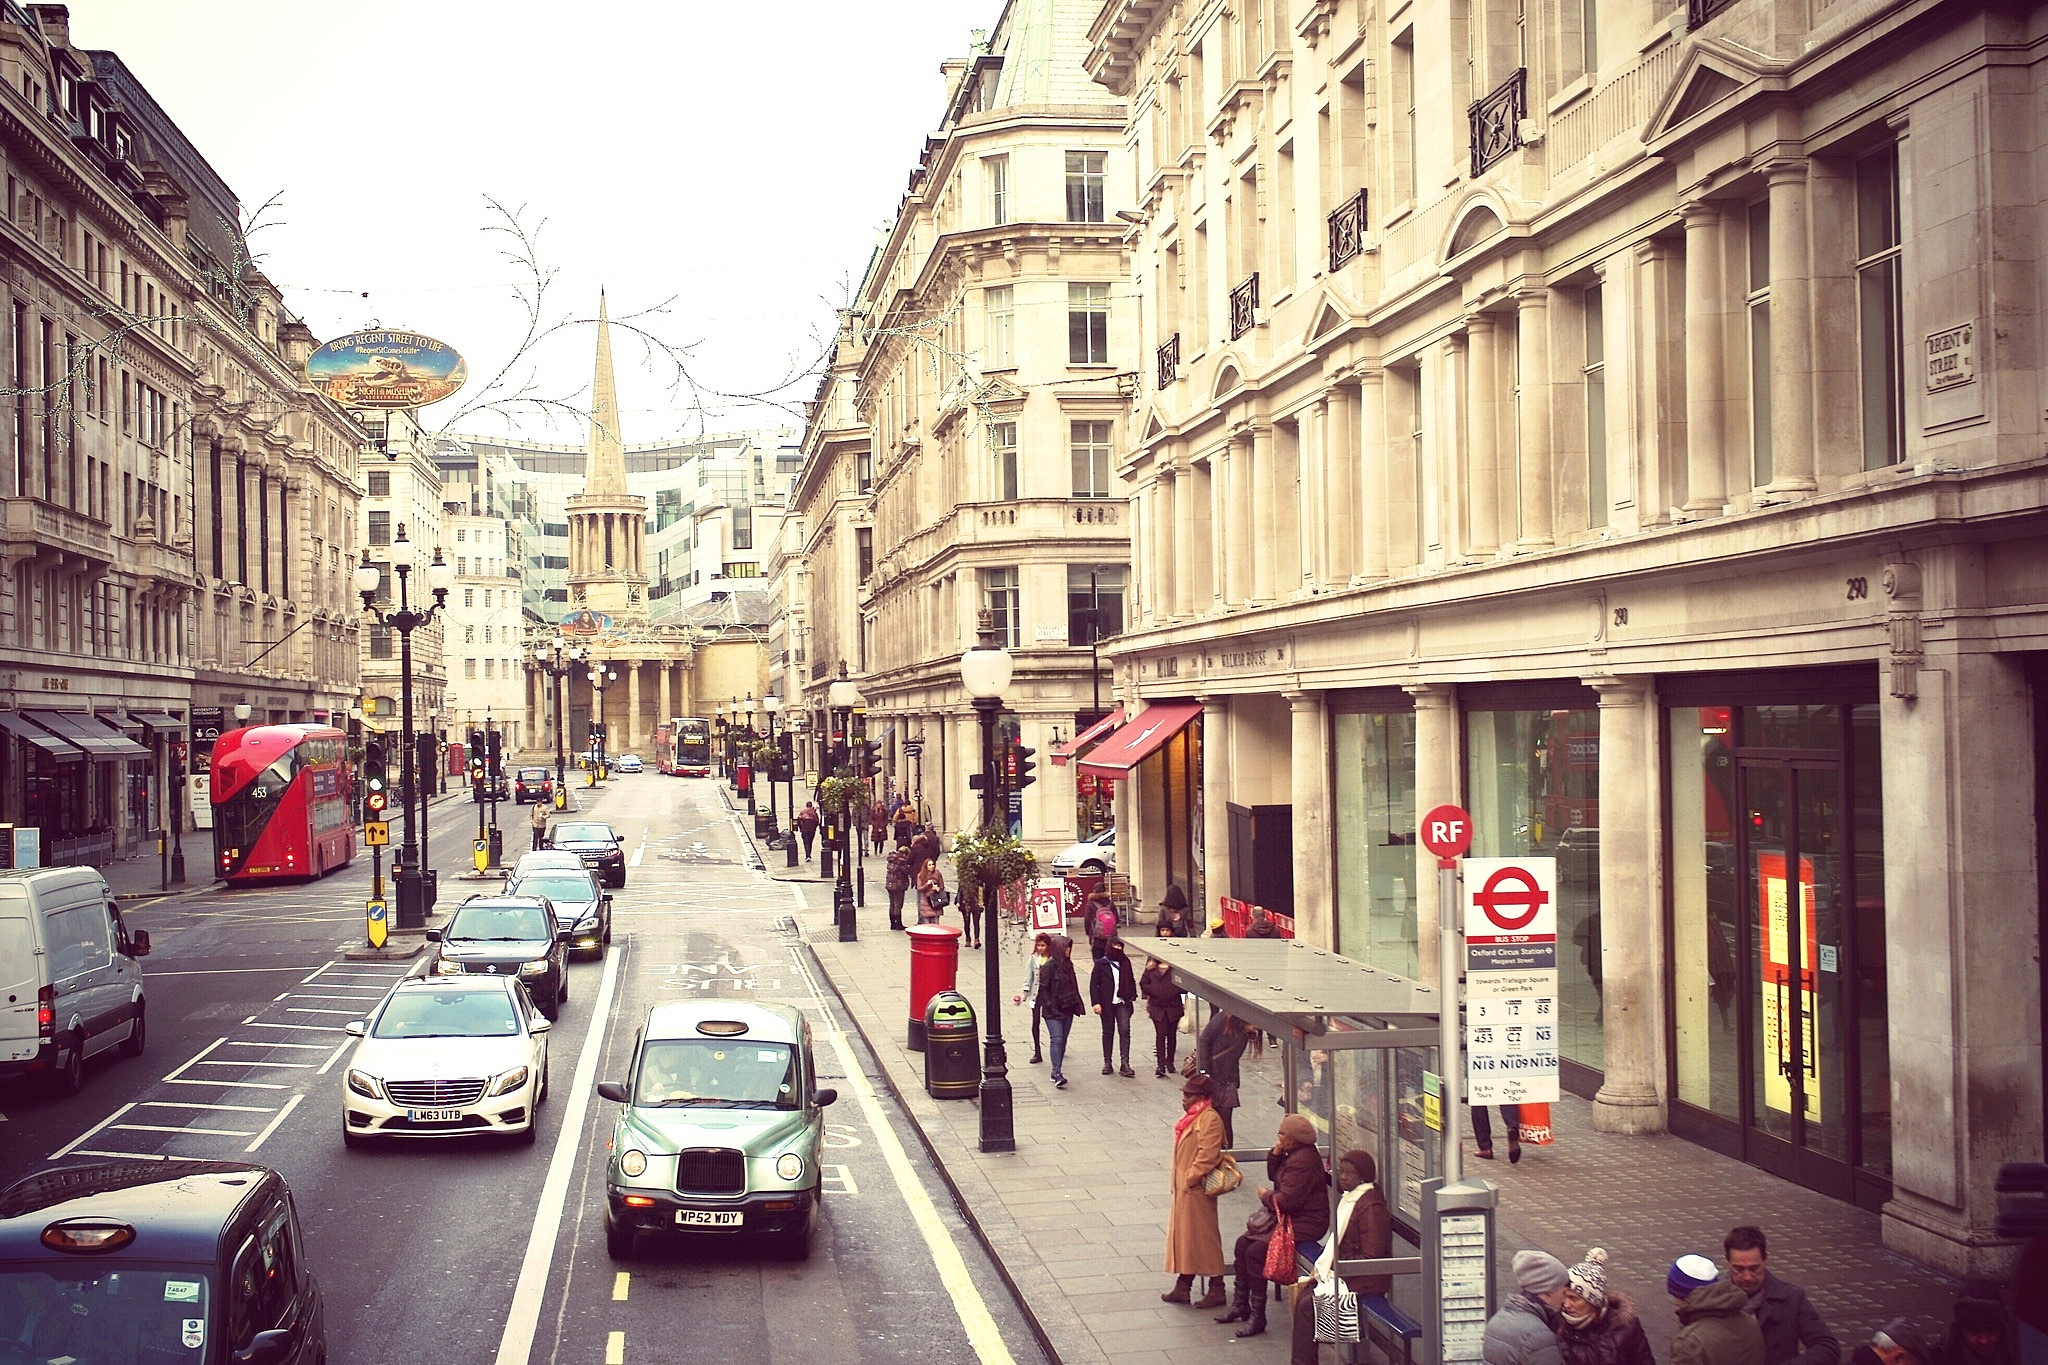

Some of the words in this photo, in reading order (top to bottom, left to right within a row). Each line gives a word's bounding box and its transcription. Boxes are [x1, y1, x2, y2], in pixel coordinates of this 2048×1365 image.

[330, 338, 354, 352] BRING
[356, 333, 385, 345] REGENT
[388, 333, 414, 345] STREET
[415, 336, 427, 348] TO
[428, 341, 444, 353] LIFE
[1929, 331, 1960, 355] REGENT
[1930, 353, 1958, 376] STREET
[359, 387, 379, 395] NIGHT
[386, 388, 415, 396] MUSEUM
[1846, 576, 1868, 600] 290
[1614, 607, 1628, 626] 290
[252, 786, 267, 798] 453
[1431, 821, 1463, 843] RF
[1480, 1007, 1486, 1016] 3
[1508, 1006, 1519, 1015] 12
[1537, 1004, 1549, 1014] 88
[1474, 1034, 1493, 1043] 453
[1507, 1032, 1521, 1042] C2
[1536, 1031, 1551, 1040] N3
[1472, 1060, 1495, 1070] N18
[1500, 1059, 1529, 1069] N109
[1530, 1057, 1558, 1068] N136
[414, 1111, 439, 1120] LM63
[442, 1110, 460, 1119] UTB
[681, 1211, 711, 1223] WP52
[715, 1213, 737, 1223] WDY
